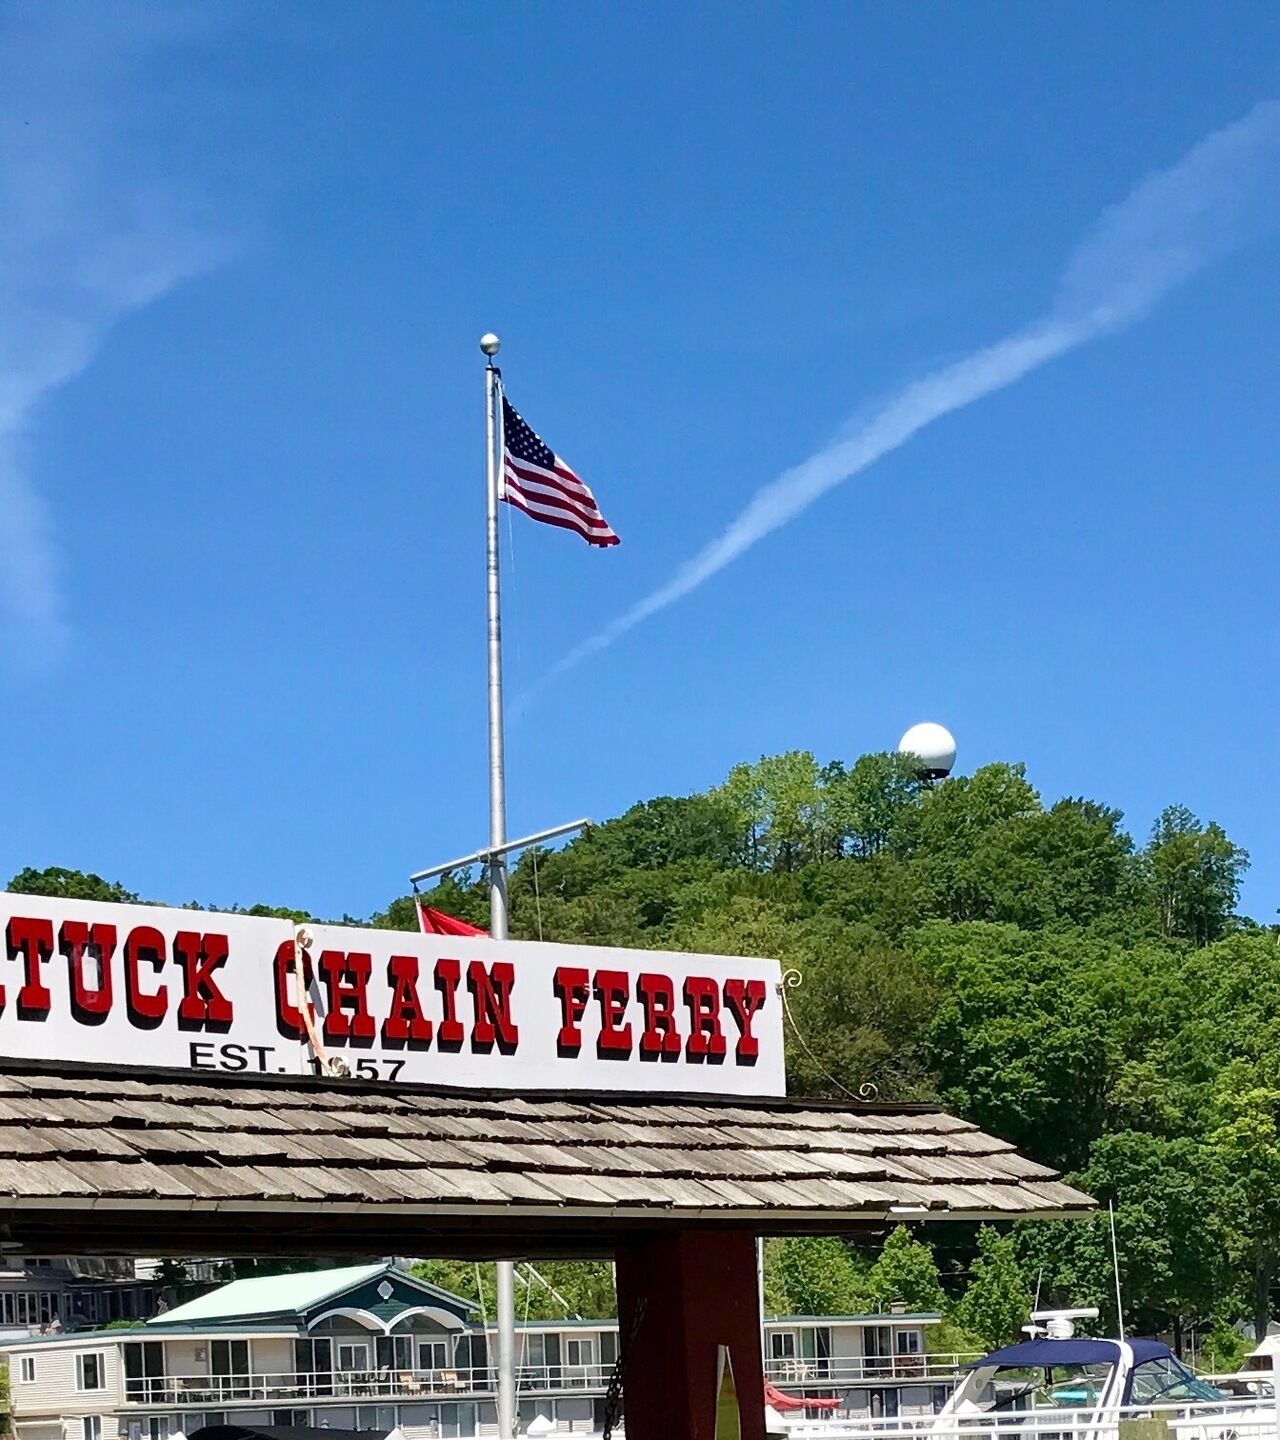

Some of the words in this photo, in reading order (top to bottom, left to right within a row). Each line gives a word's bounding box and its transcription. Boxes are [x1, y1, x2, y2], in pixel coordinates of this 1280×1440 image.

[273, 939, 520, 1056] CHAIN
[553, 966, 768, 1067] FERRY
[189, 1041, 287, 1072] EST.
[307, 1058, 406, 1082] 157
